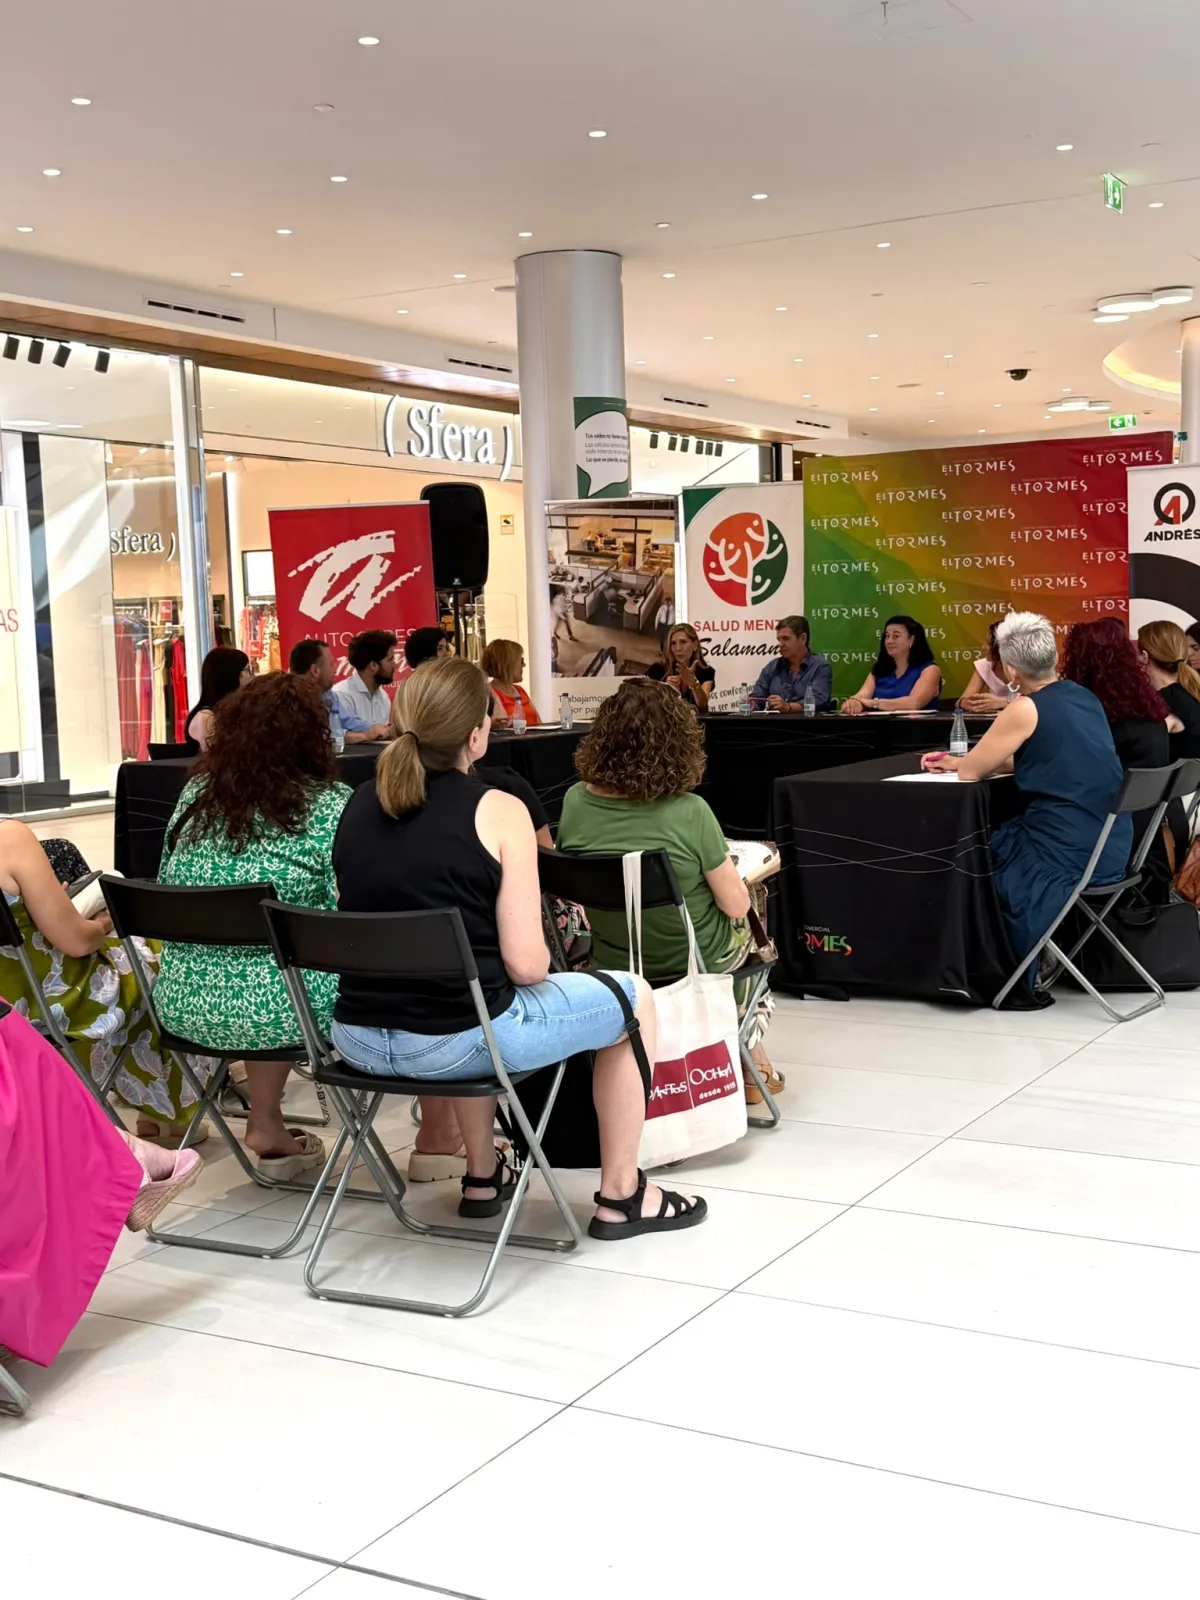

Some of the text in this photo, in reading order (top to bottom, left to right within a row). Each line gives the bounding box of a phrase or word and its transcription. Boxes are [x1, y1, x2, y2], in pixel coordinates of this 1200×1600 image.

[407, 404, 496, 464] Sfera
[1082, 502, 1128, 515] ELTOR
[110, 525, 164, 555] Sfera
[1143, 528, 1200, 542] ANDRÉS
[1082, 551, 1129, 563] ELTOR
[1082, 599, 1129, 612] ELTOR
[0, 608, 19, 632] AS
[694, 621, 740, 632] SALUD
[699, 637, 781, 657] Salaman
[824, 652, 878, 664] TORMES
[942, 650, 982, 662] ELTOR
[699, 1087, 721, 1100] desde
